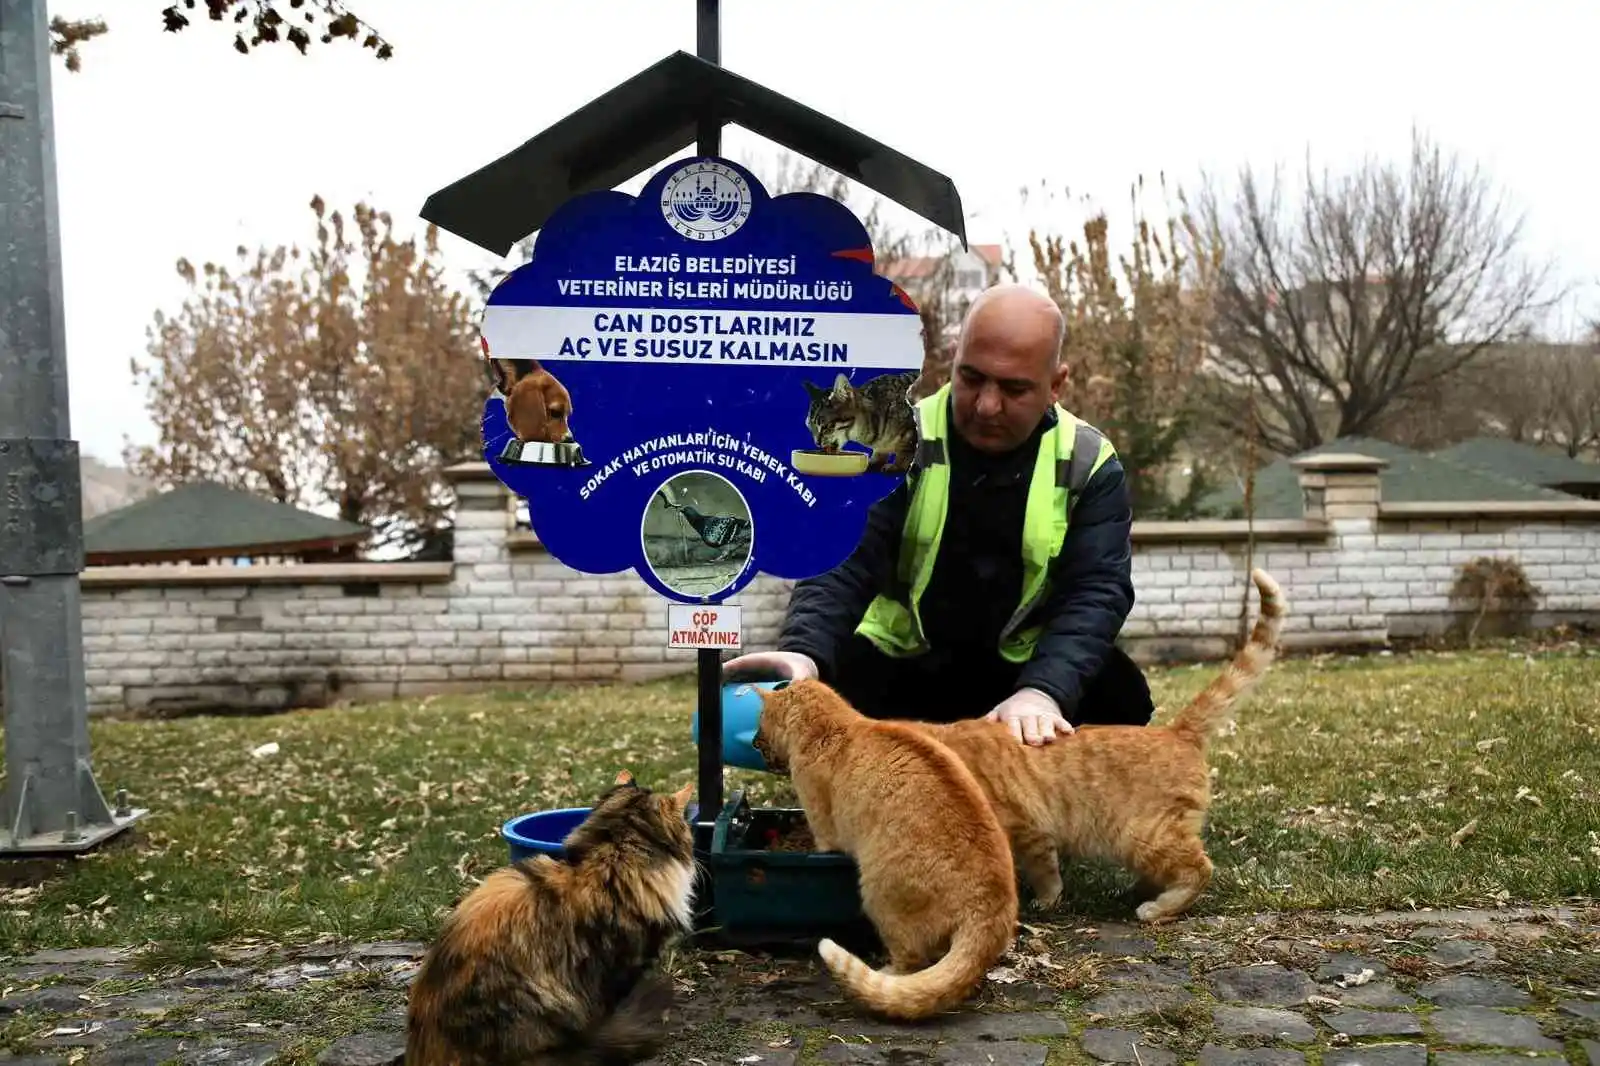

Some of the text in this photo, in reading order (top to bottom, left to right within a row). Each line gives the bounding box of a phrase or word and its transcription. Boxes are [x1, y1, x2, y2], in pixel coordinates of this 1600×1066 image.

[615, 254, 796, 275] ELAZIĞ BELEDİYESİ
[558, 276, 853, 301] VETERİNER İŞLERİ MÜDÜRLÜĞÜ
[594, 313, 815, 337] CAN DOSTLARIMIZ
[559, 337, 848, 362] AÇ VE SUSUZ KALMASIN
[580, 431, 817, 508] SOKAK HAYVANLARI İÇİN YEMEK KABI
[632, 448, 767, 484] VE OTOMATİK SU KABI
[692, 609, 718, 628] ÇÖP
[671, 630, 739, 645] ATMAYINIZ
